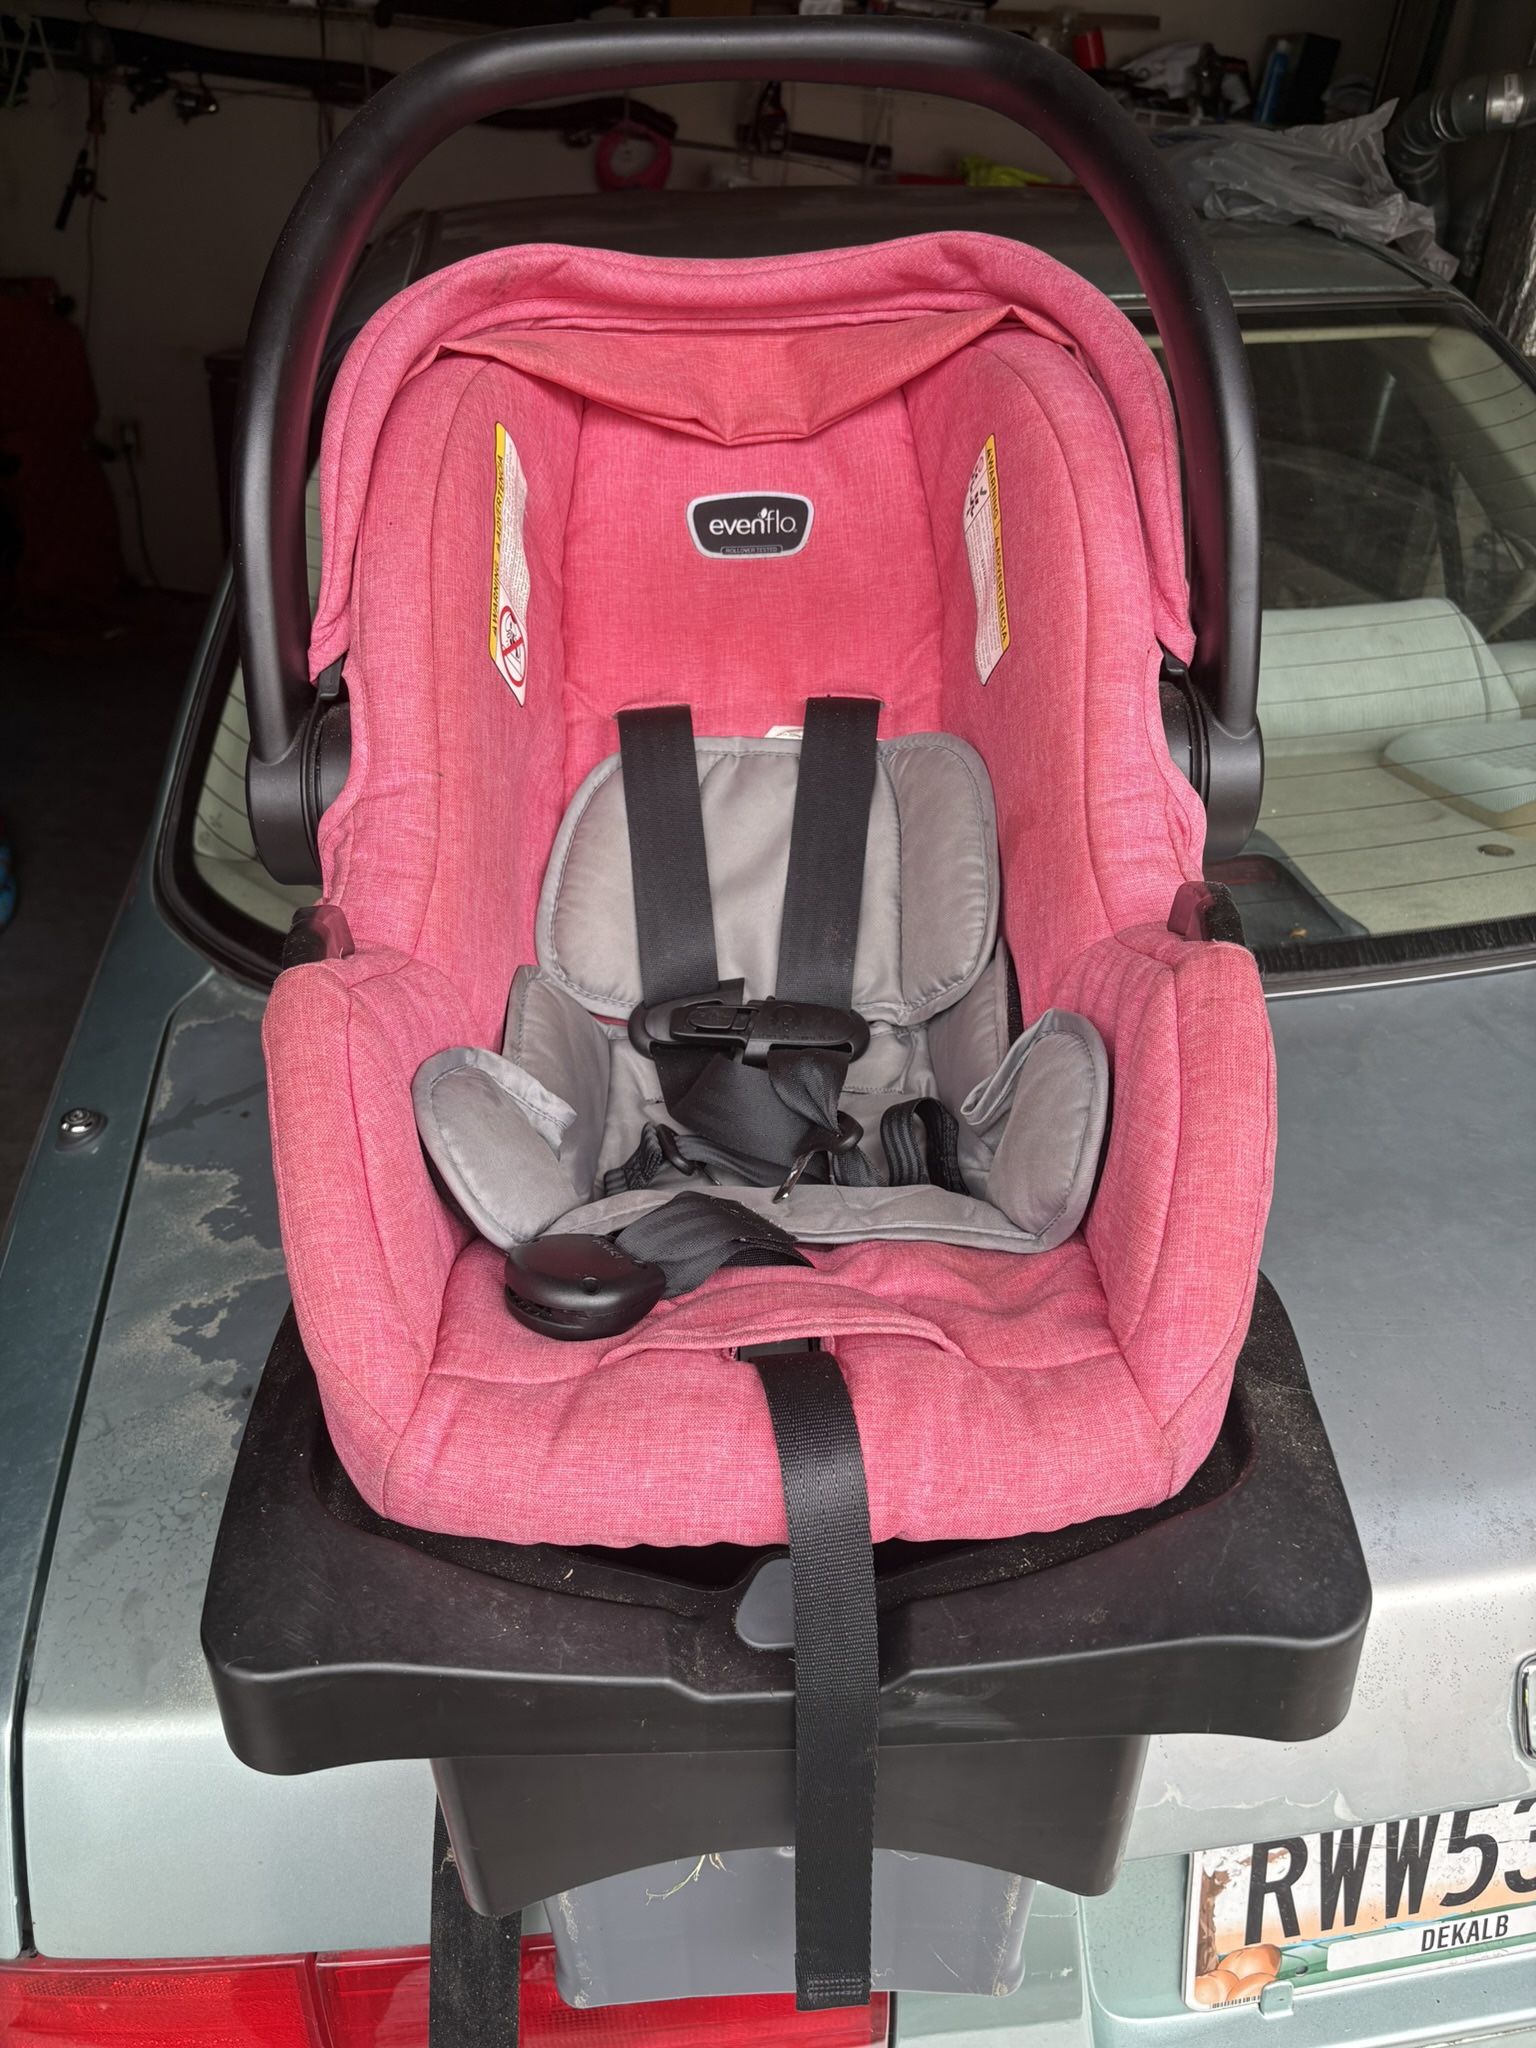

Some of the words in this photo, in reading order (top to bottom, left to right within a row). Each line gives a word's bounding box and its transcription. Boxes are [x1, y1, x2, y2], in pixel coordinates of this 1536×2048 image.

[495, 455, 505, 542] ADVERTENCIA
[987, 456, 999, 520] WARNING
[708, 508, 796, 536] evenflo
[492, 561, 500, 623] WARNING
[1421, 1914, 1509, 1952] DEKALB
